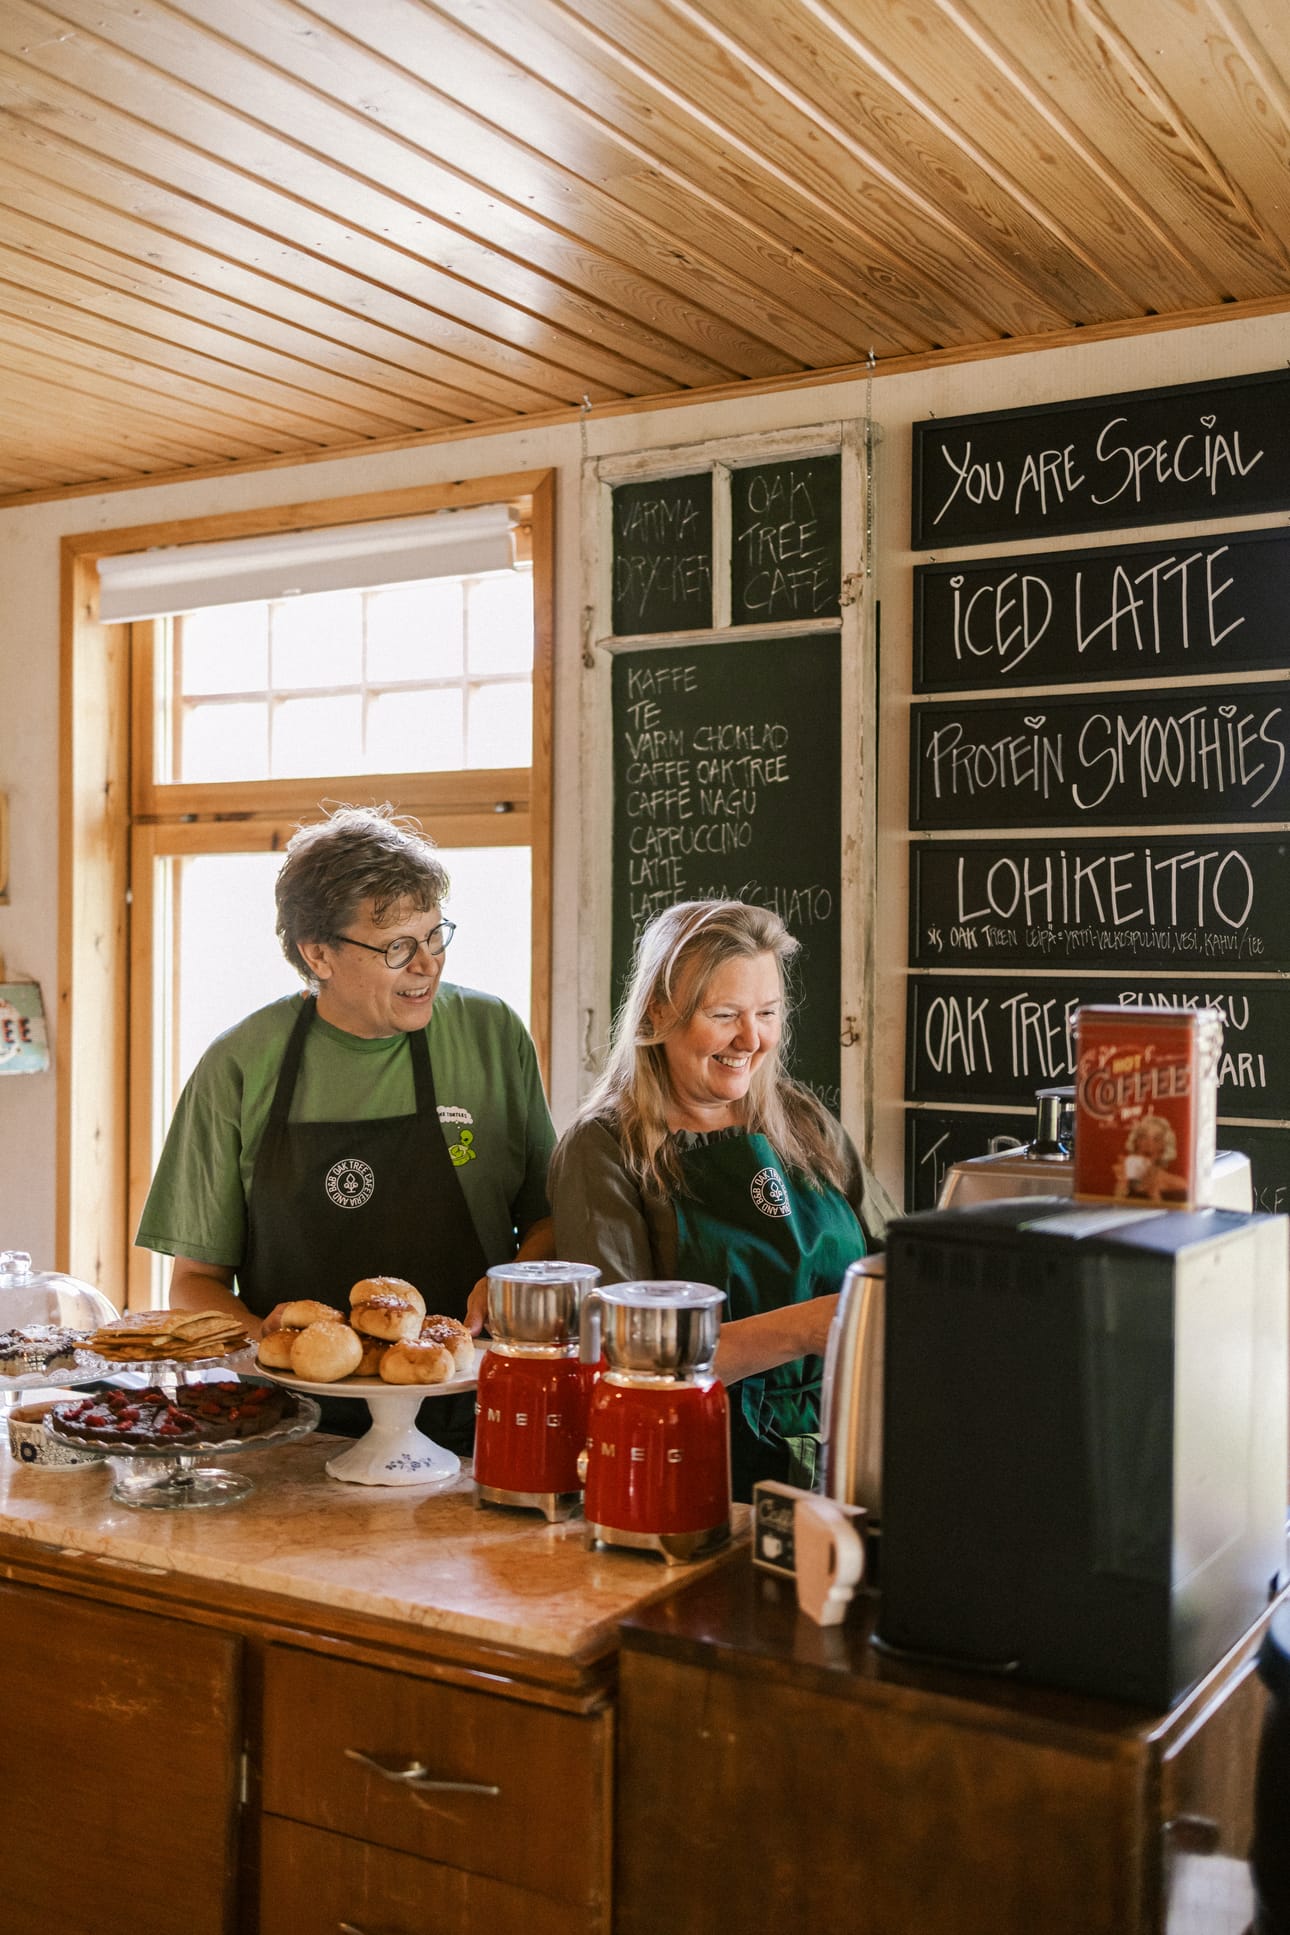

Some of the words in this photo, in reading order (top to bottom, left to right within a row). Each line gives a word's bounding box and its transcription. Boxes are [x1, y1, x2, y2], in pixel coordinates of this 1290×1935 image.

[748, 471, 816, 522] OAK
[1015, 444, 1085, 515] ARE
[738, 519, 825, 567] TREE
[1076, 545, 1246, 654] LATTE
[627, 665, 699, 699] KAFFE
[626, 699, 662, 730] TE
[625, 729, 684, 760] VARM
[692, 722, 789, 752] CHOKLAD
[699, 788, 757, 819] NAGU
[629, 821, 752, 858] CAPPUCCINO
[629, 856, 687, 888] LATTE
[950, 926, 979, 951] OAK
[925, 996, 993, 1076] OAK
[1078, 1063, 1191, 1121] COFFEE
[332, 1161, 349, 1176] OAK
[349, 1160, 369, 1175] TREE
[332, 1191, 349, 1206] AND
